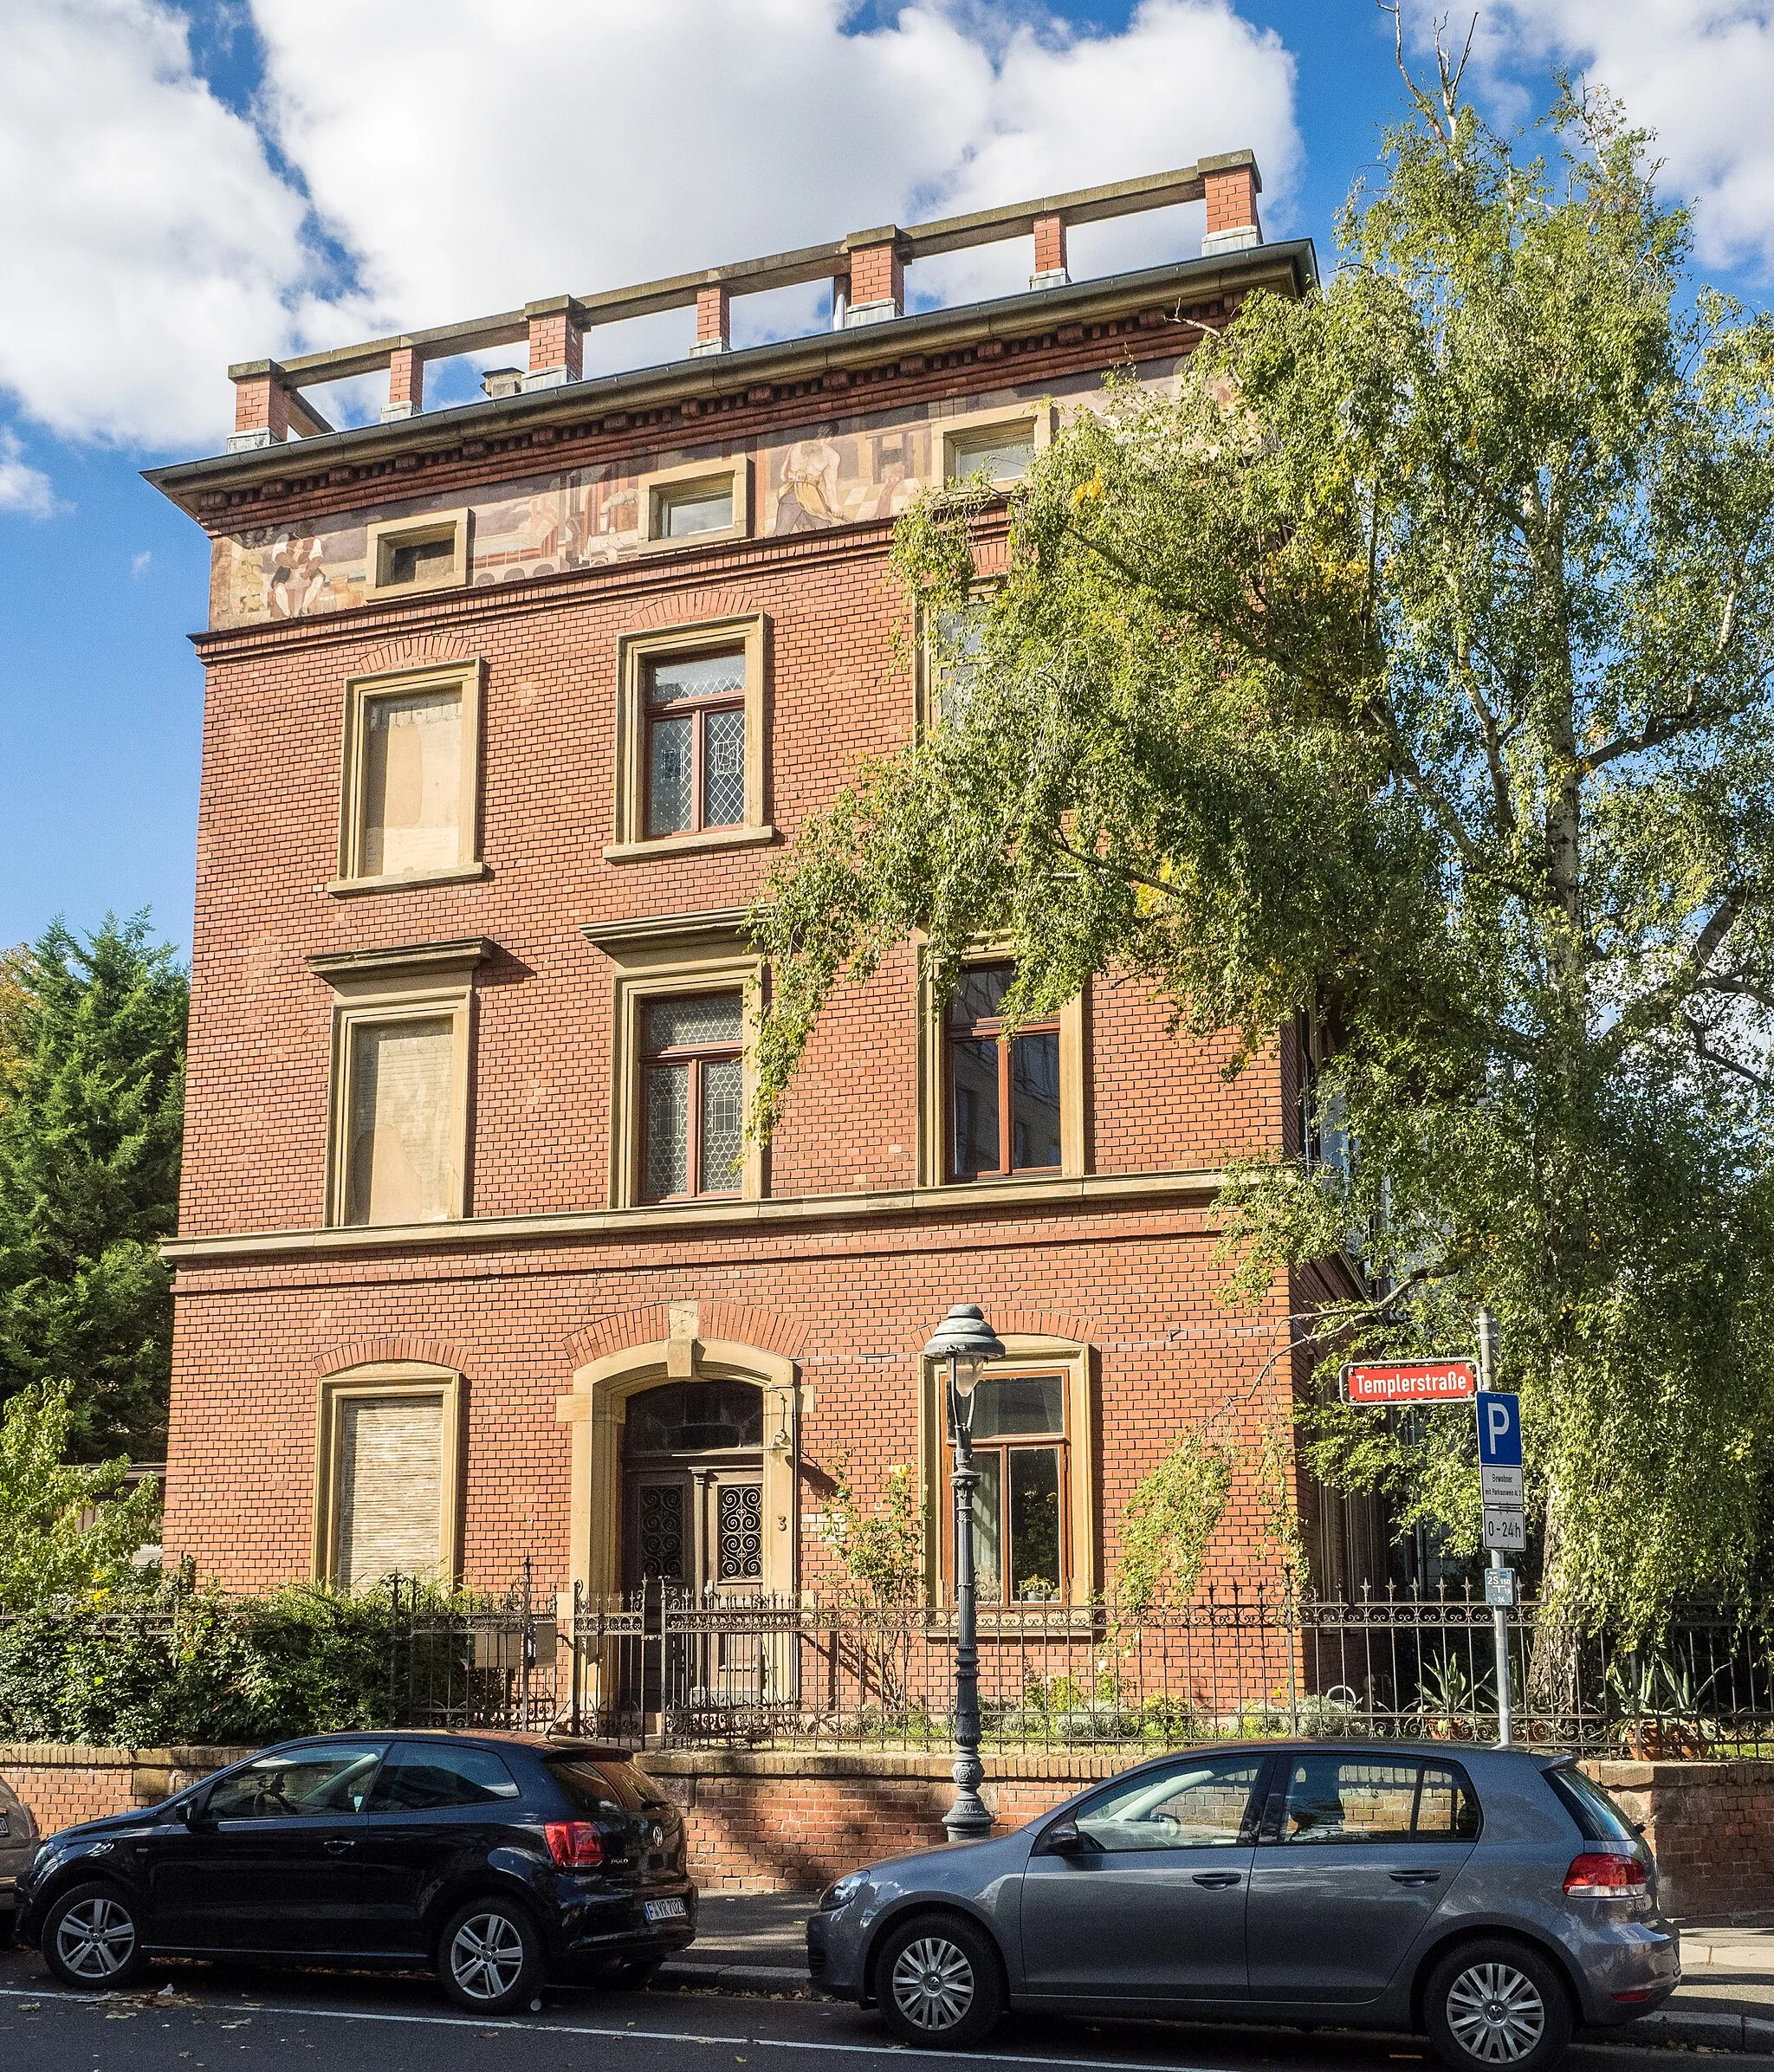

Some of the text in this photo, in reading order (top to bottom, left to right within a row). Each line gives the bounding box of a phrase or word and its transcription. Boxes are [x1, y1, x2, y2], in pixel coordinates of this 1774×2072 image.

[1356, 1370, 1466, 1397] Templerstraße
[1487, 1402, 1510, 1455] P
[777, 1516, 787, 1531] 3
